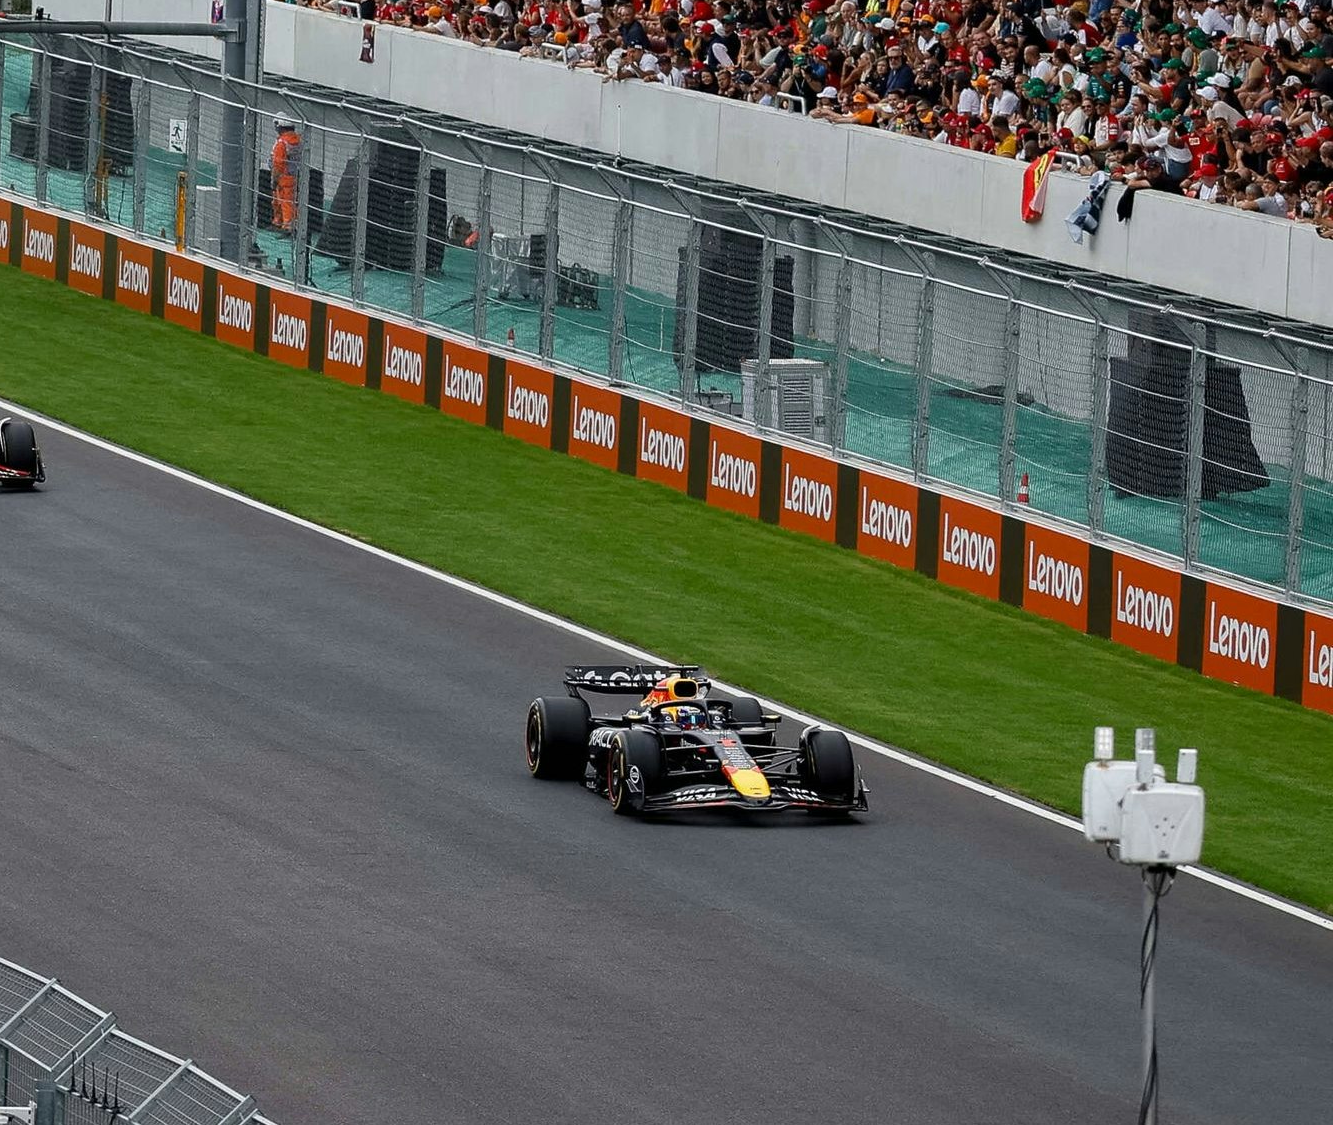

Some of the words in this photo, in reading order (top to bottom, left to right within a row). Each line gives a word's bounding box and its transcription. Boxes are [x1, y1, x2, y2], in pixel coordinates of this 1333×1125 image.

[24, 219, 54, 262] Lenovo
[71, 234, 101, 278] Lenovo
[118, 251, 149, 295] Lenovo
[167, 267, 199, 313] Lenovo
[219, 285, 252, 331] Lenovo
[272, 304, 306, 350] Lenovo
[328, 320, 363, 367] Lenovo
[385, 336, 422, 385] Lenovo
[445, 355, 483, 405] Lenovo
[508, 375, 548, 427] Lenovo
[573, 396, 615, 449] Lenovo
[641, 417, 685, 472] Lenovo
[711, 441, 755, 497] Lenovo
[785, 463, 832, 521] Lenovo
[862, 487, 911, 547] Lenovo
[943, 513, 995, 575] Lenovo
[1029, 541, 1082, 605] Lenovo
[1117, 571, 1173, 636] Lenovo
[1210, 602, 1269, 668] Lenovo
